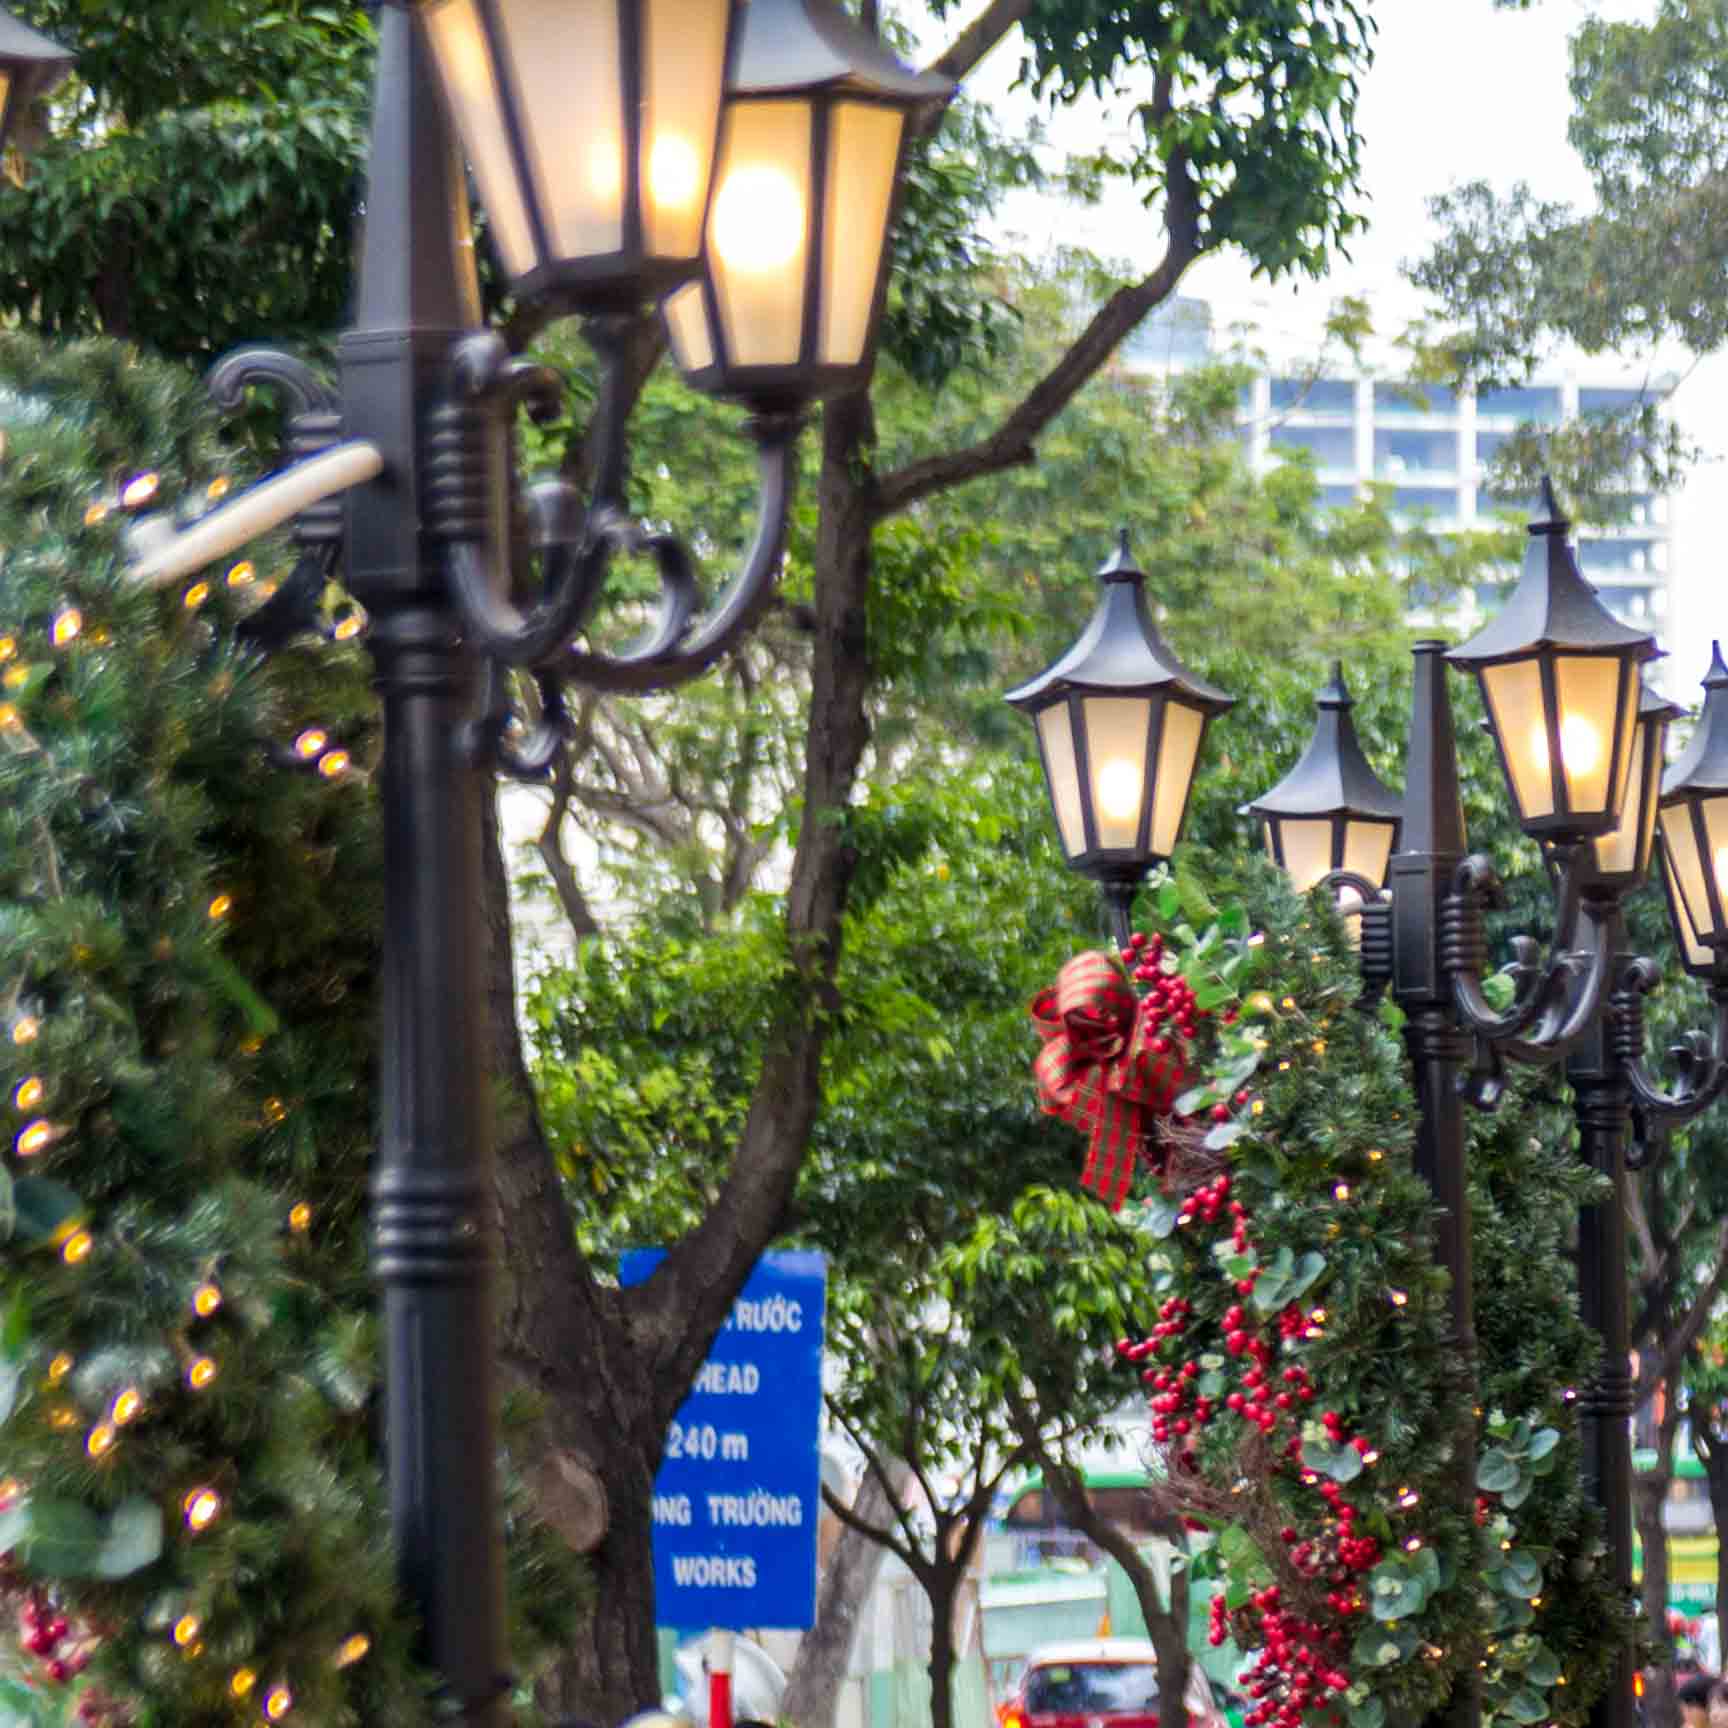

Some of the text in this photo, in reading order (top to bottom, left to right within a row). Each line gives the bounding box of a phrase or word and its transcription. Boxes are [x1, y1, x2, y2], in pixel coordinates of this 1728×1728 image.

[724, 1293, 802, 1333] RƯỚC
[694, 1362, 760, 1394] HEAD
[667, 1423, 748, 1460] 240 m
[653, 1487, 802, 1526] NG TRƯỜNG
[673, 1556, 757, 1588] WORKS
